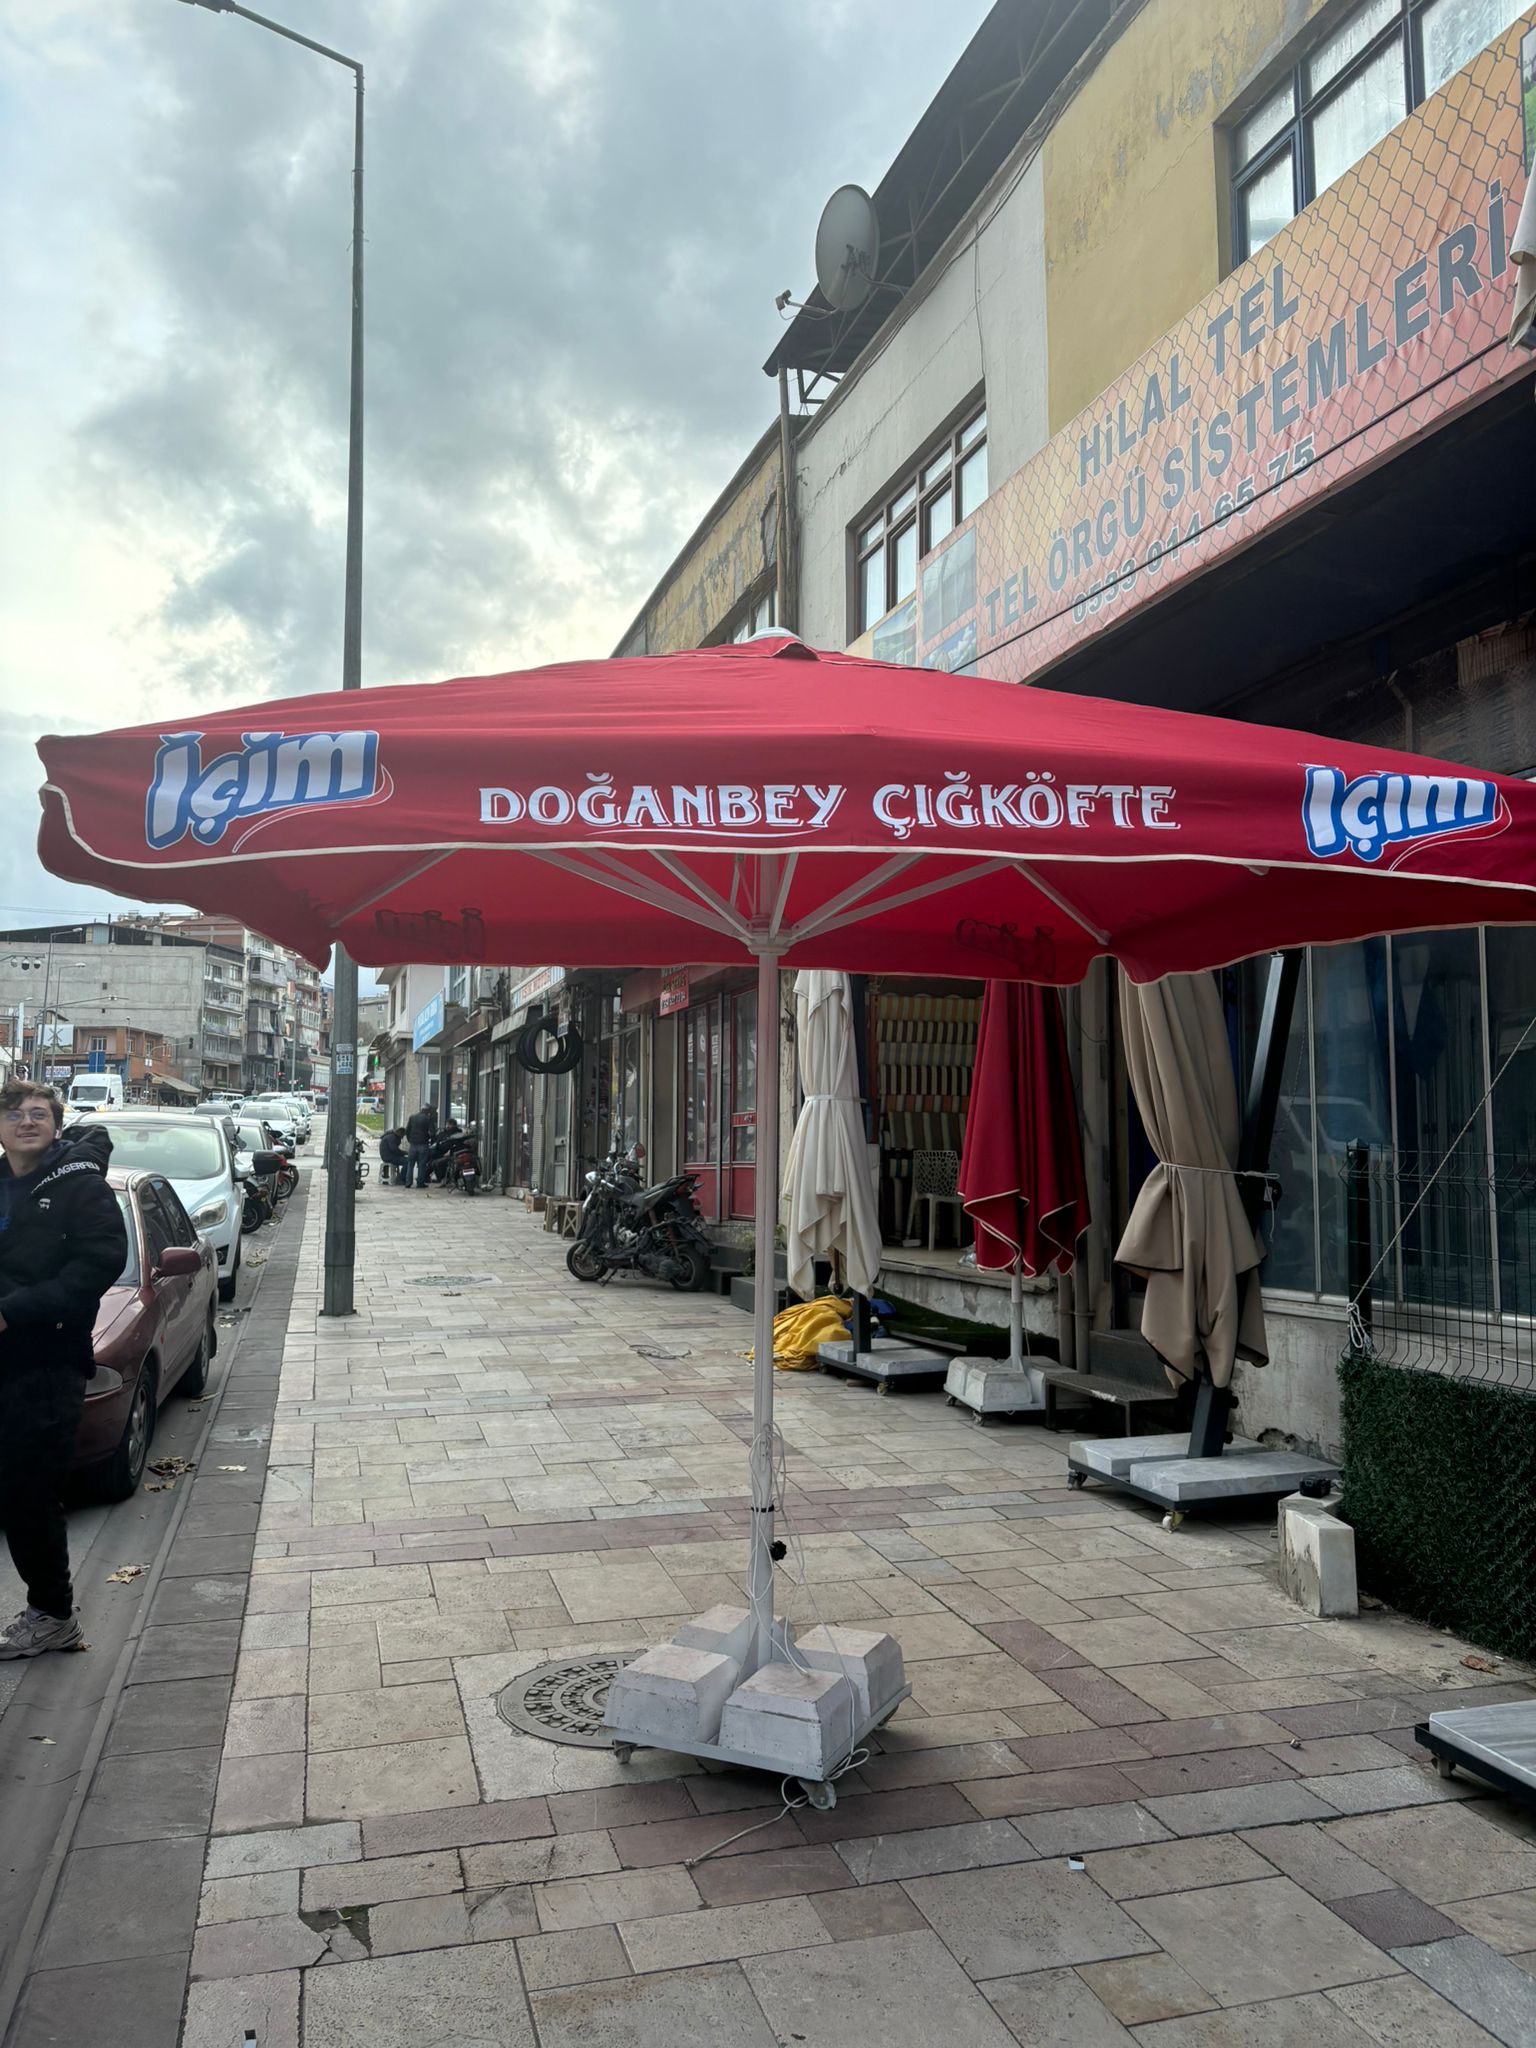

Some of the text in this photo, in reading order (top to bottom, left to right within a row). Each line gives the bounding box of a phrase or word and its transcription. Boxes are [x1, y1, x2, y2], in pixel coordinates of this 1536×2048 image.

[1207, 261, 1299, 376] TEL
[985, 177, 1507, 637] TEL ÖRGÜ SİSTEMLERİ
[1072, 432, 1317, 624] 0533 014 65 75
[478, 771, 1181, 839] DOĞANBEY ÇIĞKÖFTE
